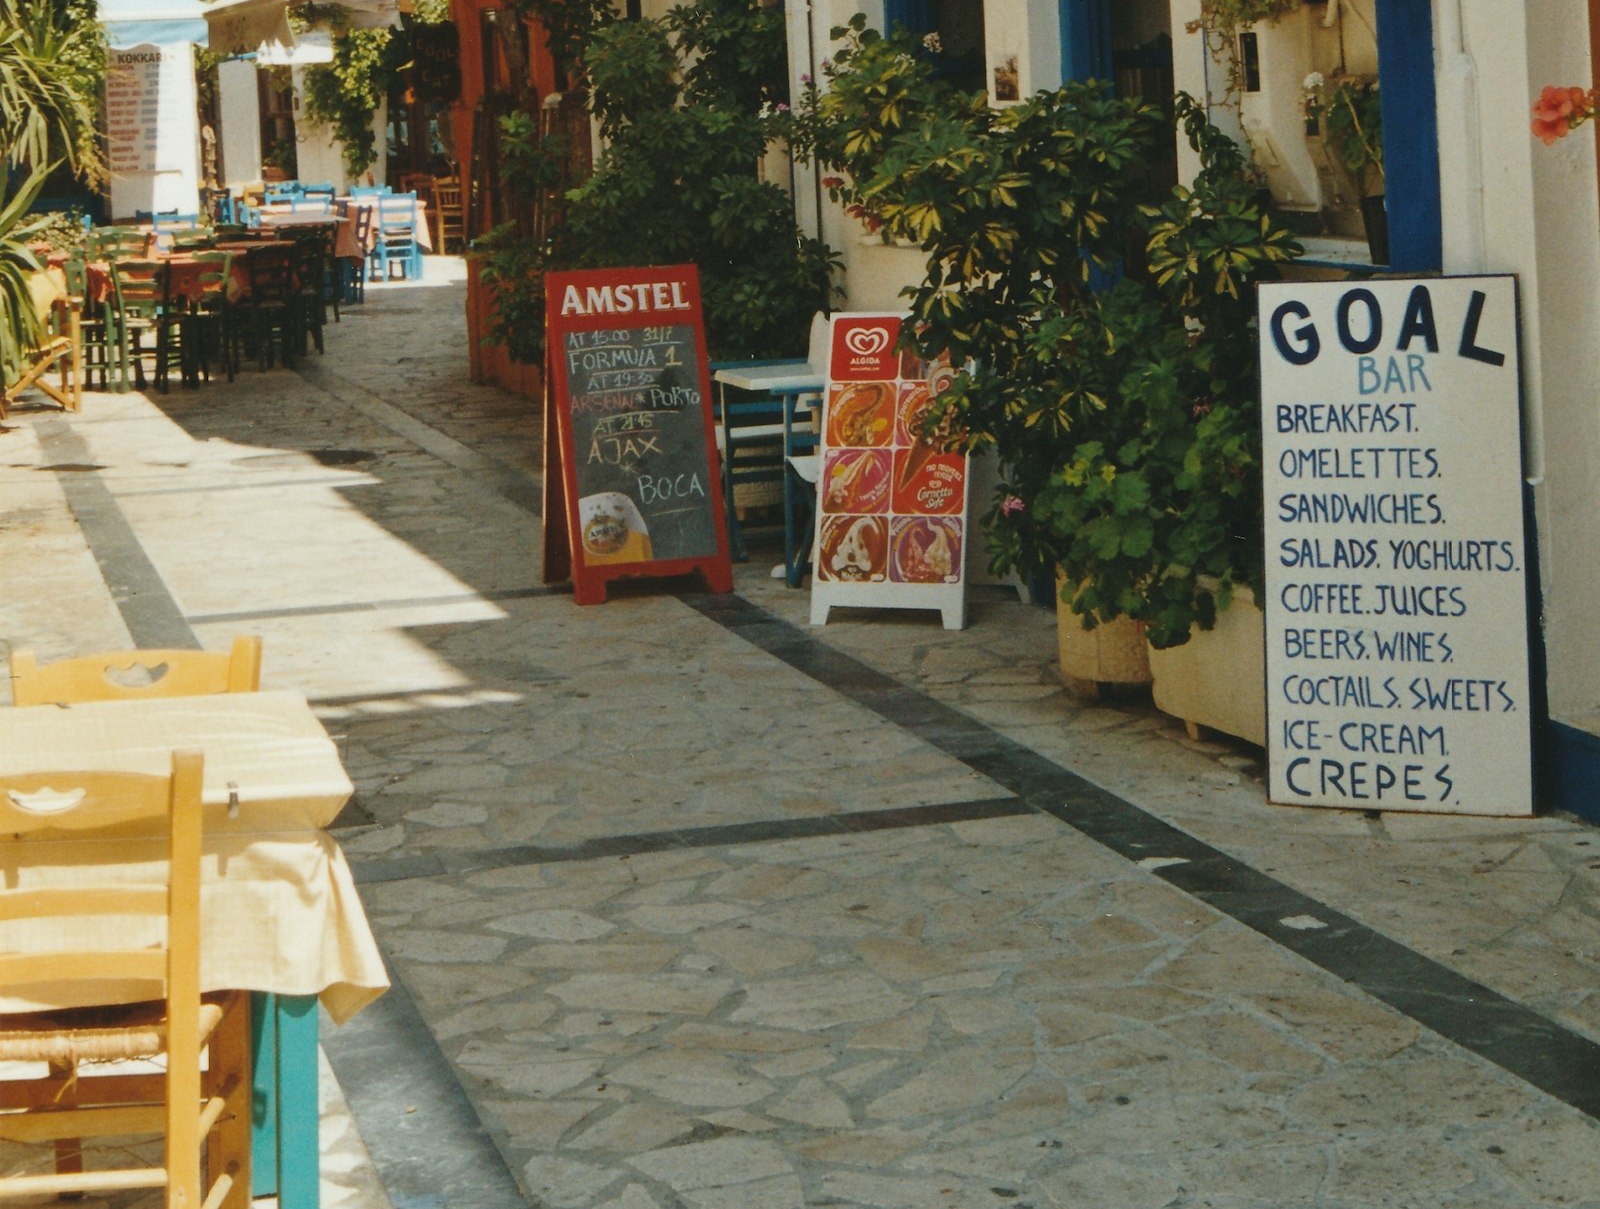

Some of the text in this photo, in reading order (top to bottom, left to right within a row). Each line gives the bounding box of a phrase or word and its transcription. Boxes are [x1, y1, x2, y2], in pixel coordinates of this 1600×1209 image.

[117, 52, 167, 64] KOKKAR
[560, 281, 690, 316] AMSTEL
[568, 331, 585, 348] AT
[1270, 284, 1506, 367] GOAL
[567, 345, 683, 375] FORMULA 1
[850, 357, 880, 365] ALGIDA
[1357, 353, 1432, 396] BAR
[586, 375, 608, 390] AT
[591, 419, 615, 435] AT
[1276, 403, 1419, 433] BREAKFAST.
[587, 436, 664, 465] AJAX
[1279, 448, 1442, 479] OMELETTES.
[637, 472, 705, 505] BOCA
[1278, 493, 1446, 524] SANDWICHES.
[1279, 537, 1521, 572] SALADS. YOGHURTS.
[1283, 674, 1517, 713] COCTAILS. SWEETS.
[1286, 757, 1460, 806] CREPES.
